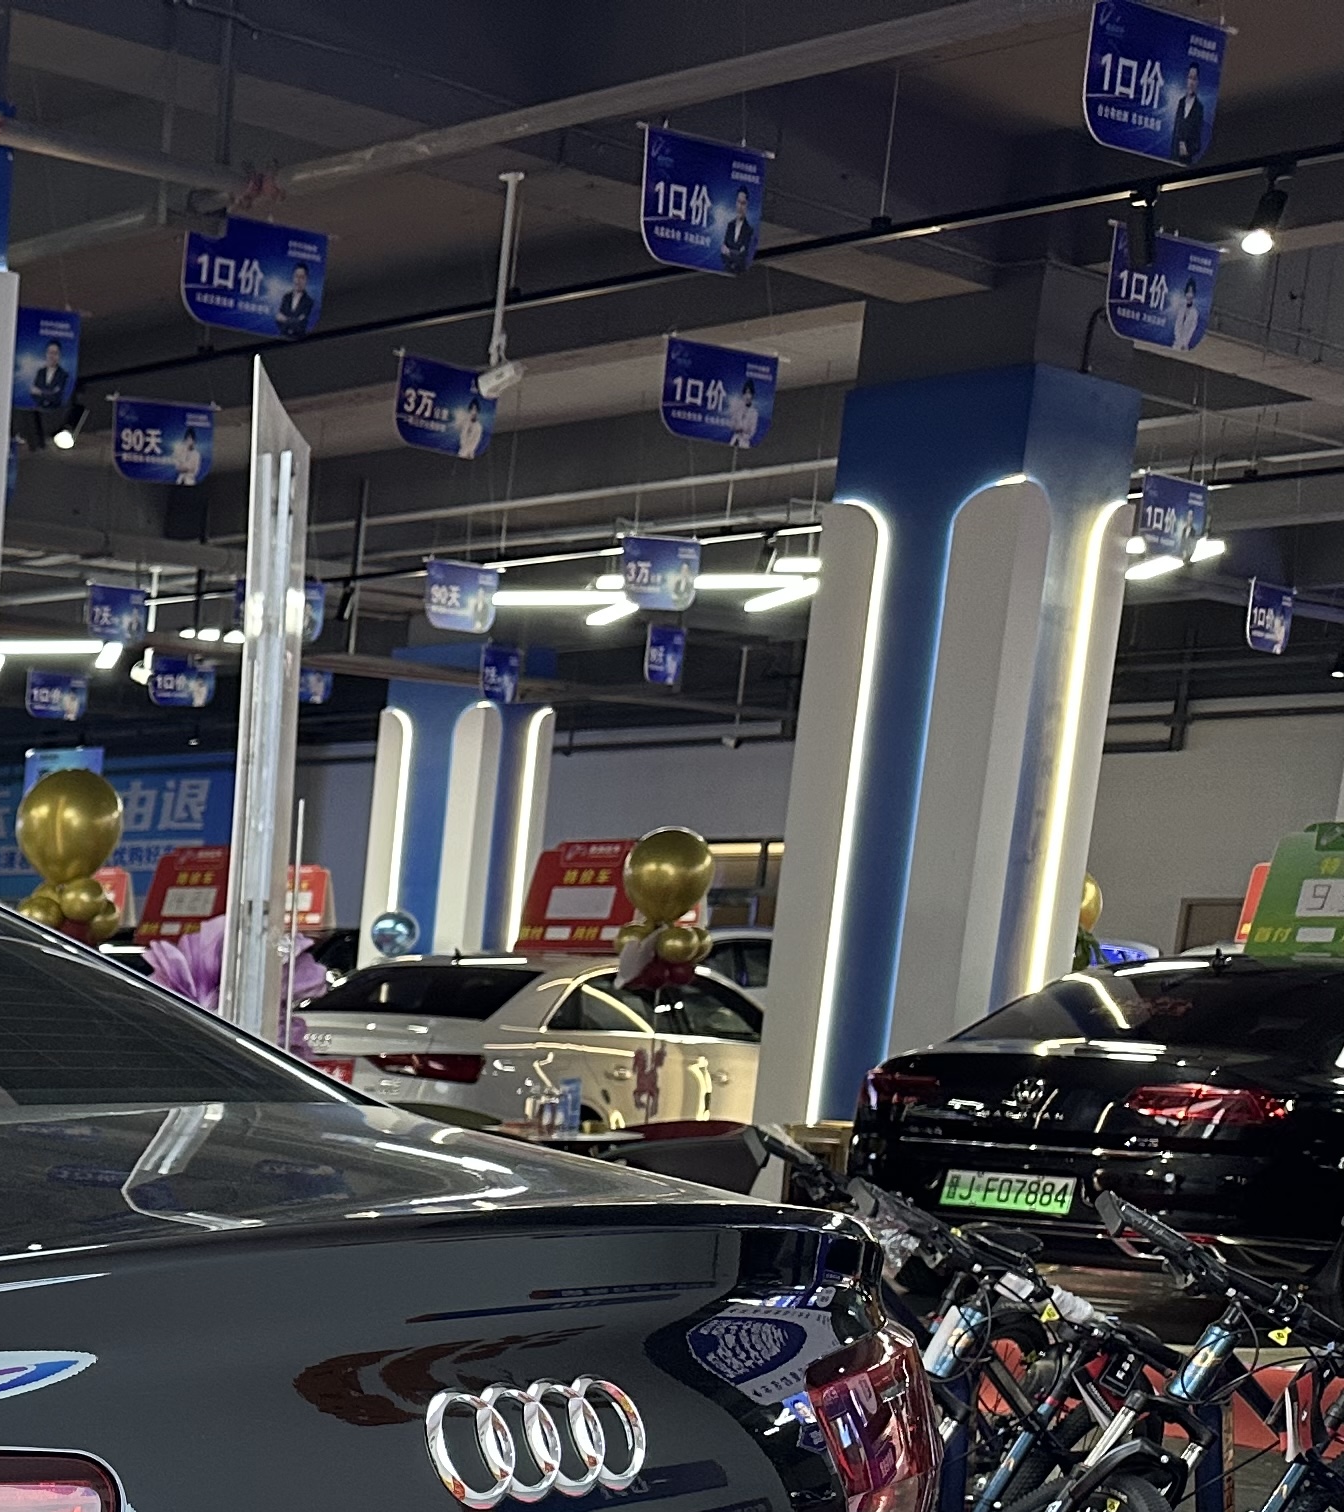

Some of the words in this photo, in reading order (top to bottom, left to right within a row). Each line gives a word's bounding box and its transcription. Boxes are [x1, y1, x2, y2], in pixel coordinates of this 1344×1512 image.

[1101, 53, 1164, 109] 1口价
[654, 180, 712, 228] 1口价
[198, 253, 264, 297] 1口价
[1119, 269, 1169, 311] 1口价
[673, 375, 727, 412] 1口价
[121, 428, 162, 455] 90天
[1145, 505, 1178, 534] 1口价
